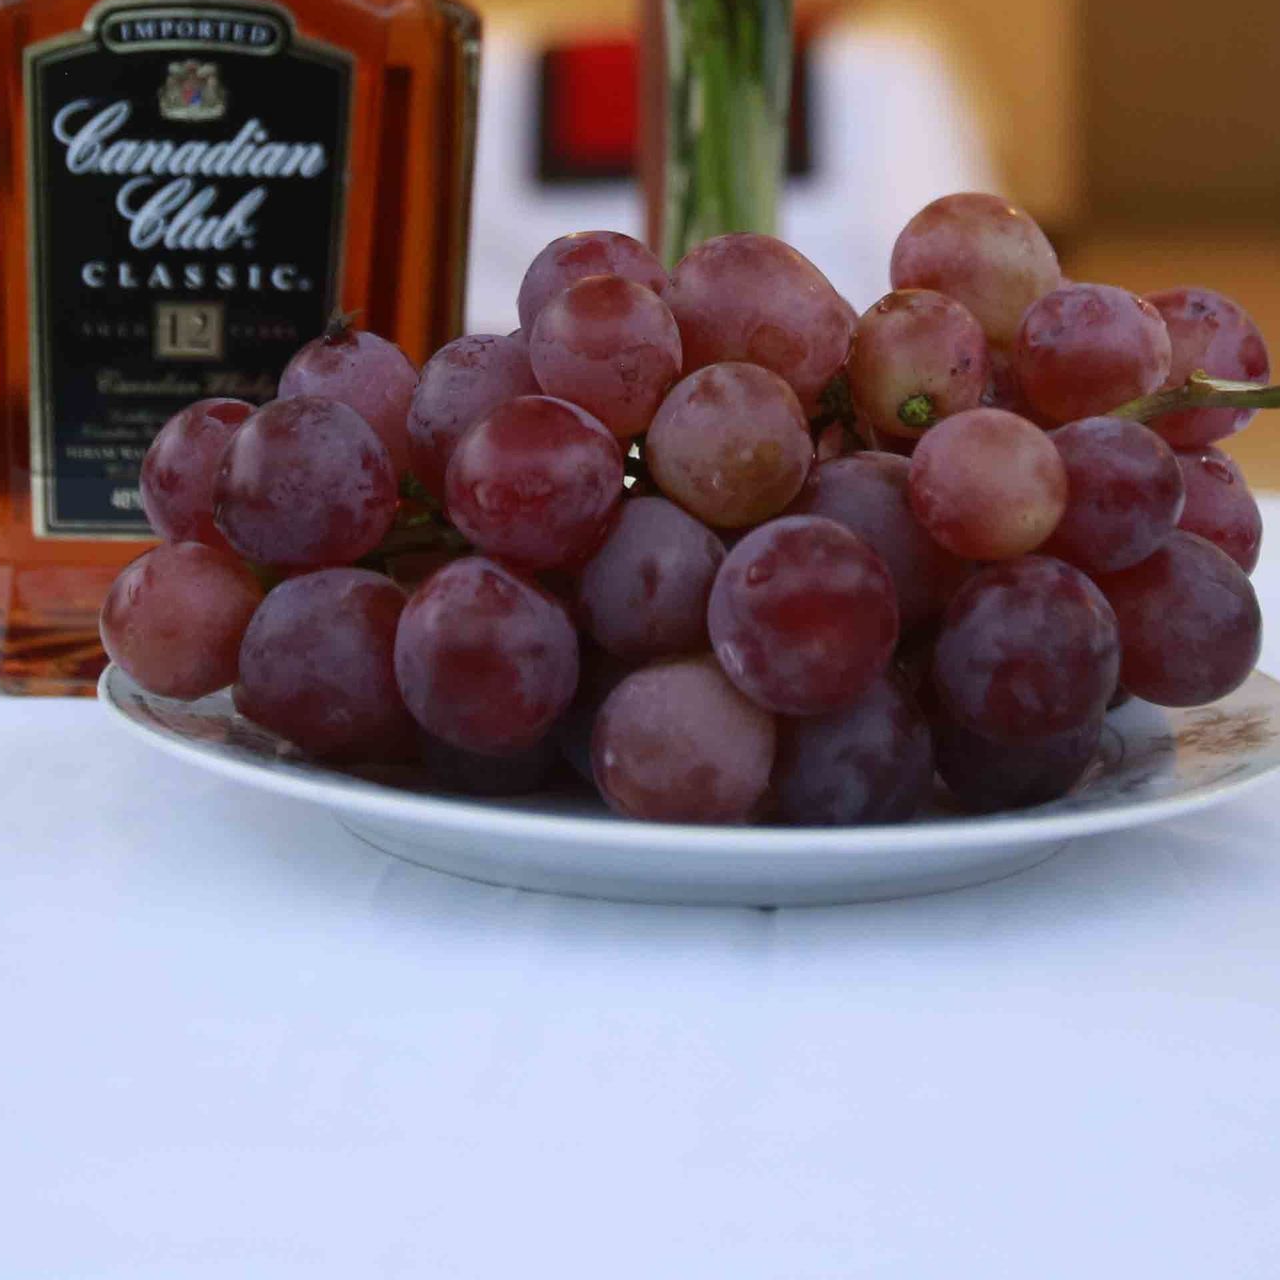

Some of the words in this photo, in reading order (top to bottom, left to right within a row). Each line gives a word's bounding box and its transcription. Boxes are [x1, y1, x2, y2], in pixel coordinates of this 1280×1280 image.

[120, 20, 268, 43] IMPORTED
[53, 99, 326, 177] Canadian
[168, 308, 212, 349] 12
